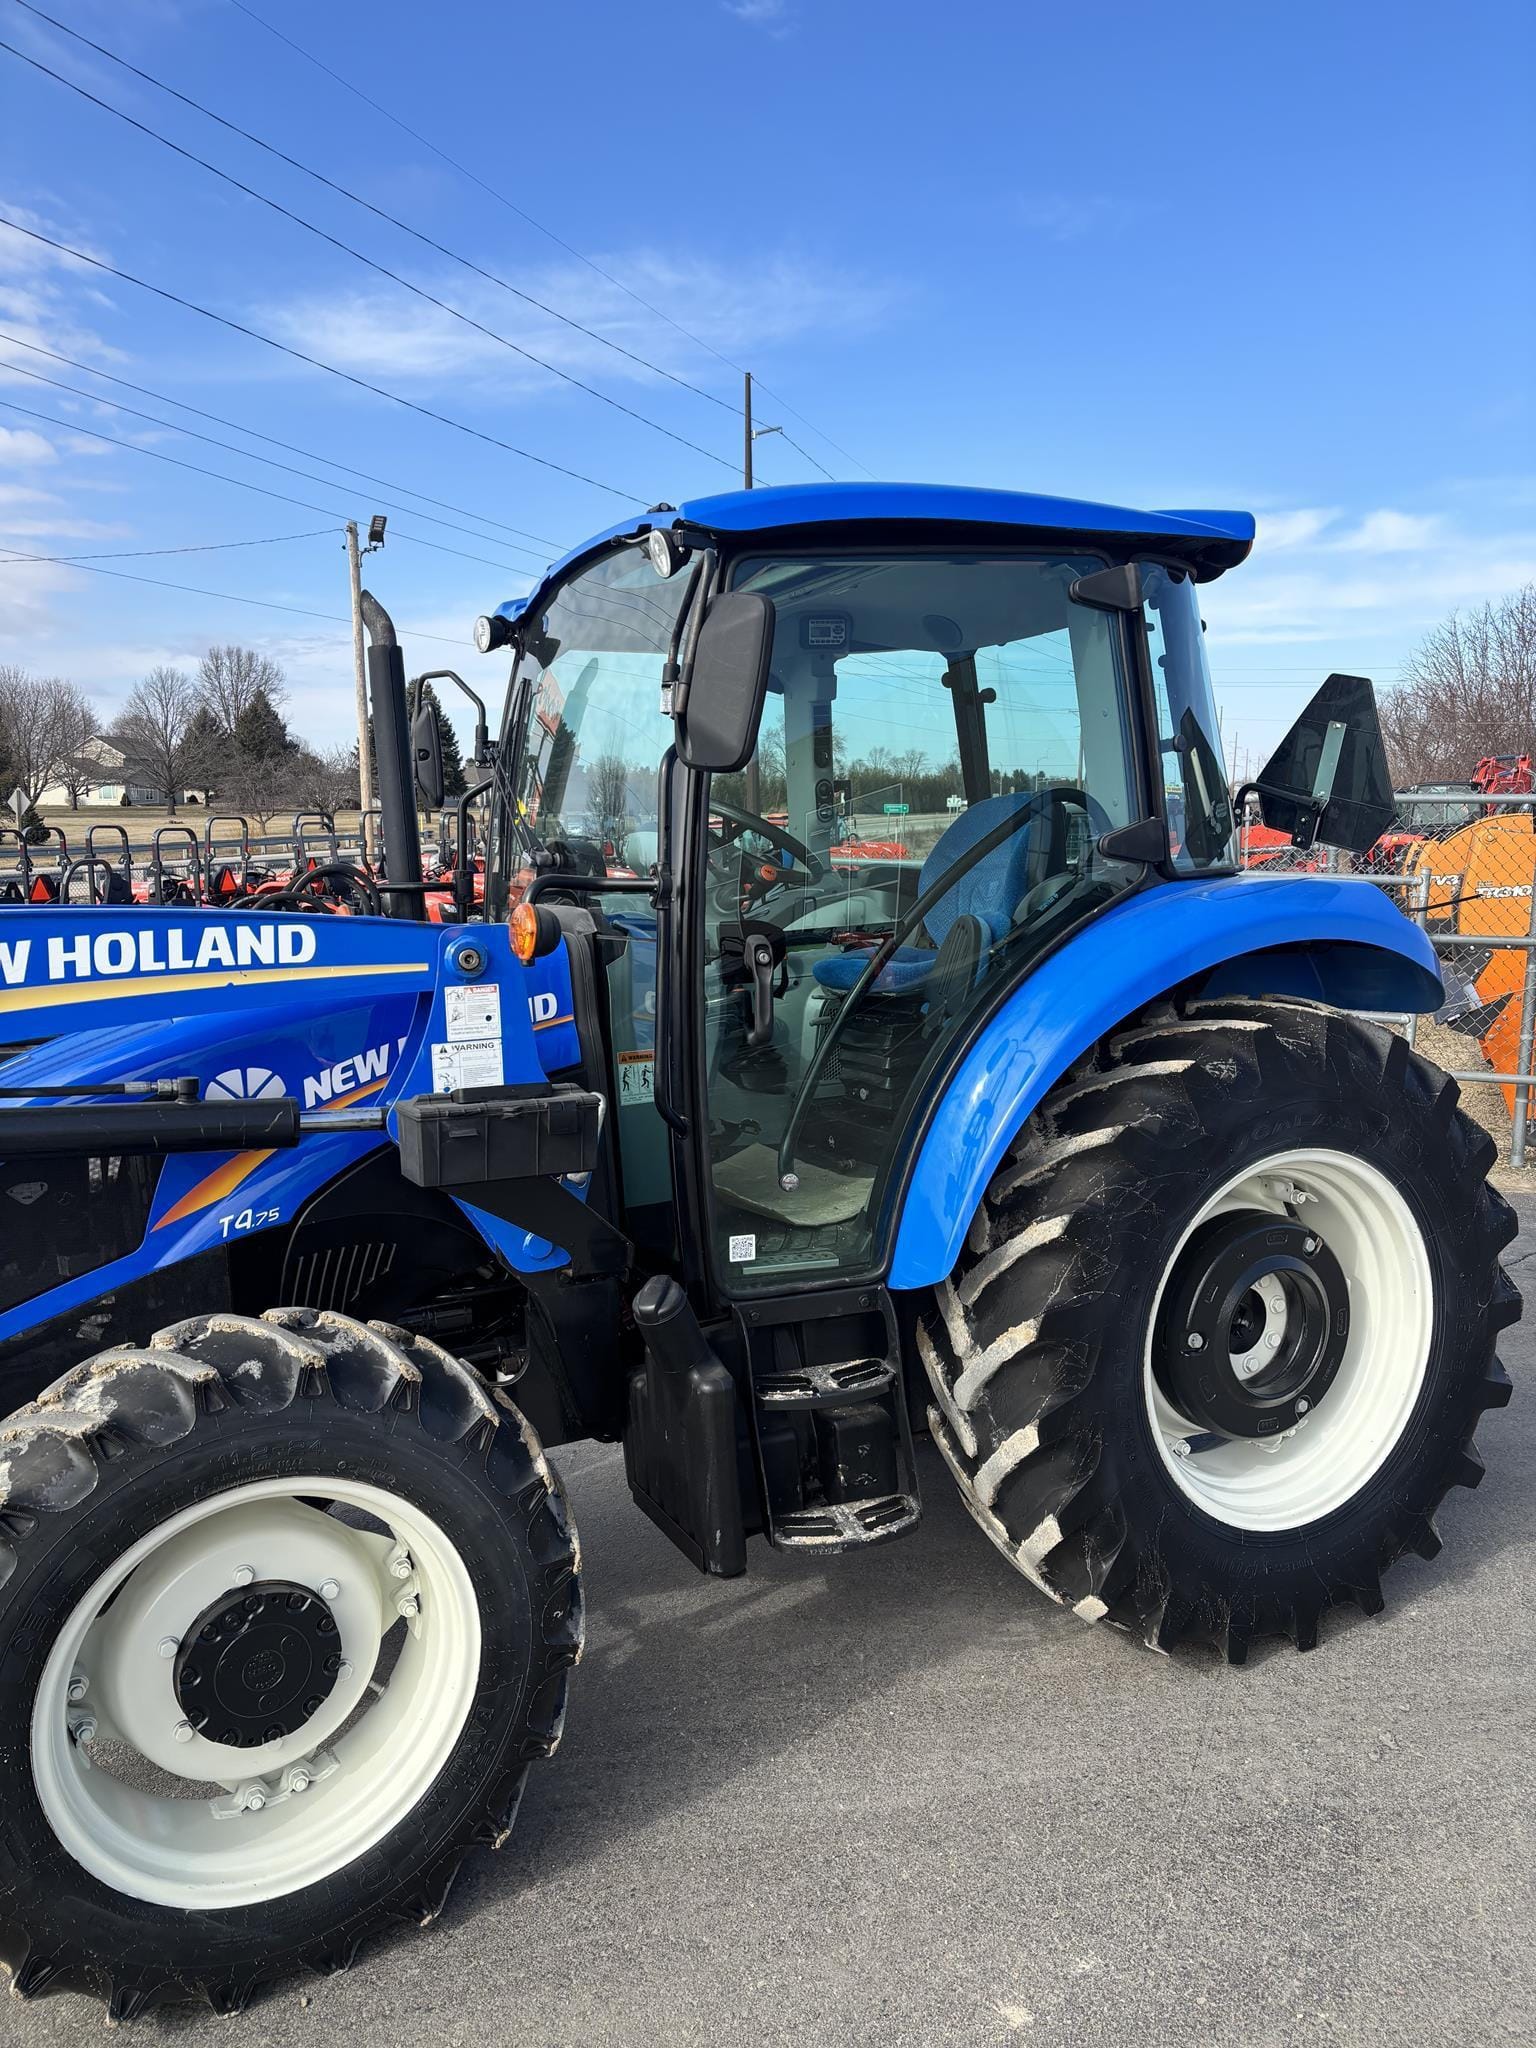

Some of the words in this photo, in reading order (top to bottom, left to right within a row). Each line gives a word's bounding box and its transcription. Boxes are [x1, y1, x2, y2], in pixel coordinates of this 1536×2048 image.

[47, 924, 317, 980] HOLLAND
[451, 1042, 495, 1051] WARNING
[303, 1043, 389, 1109] NEW
[218, 1207, 280, 1238] T4.75
